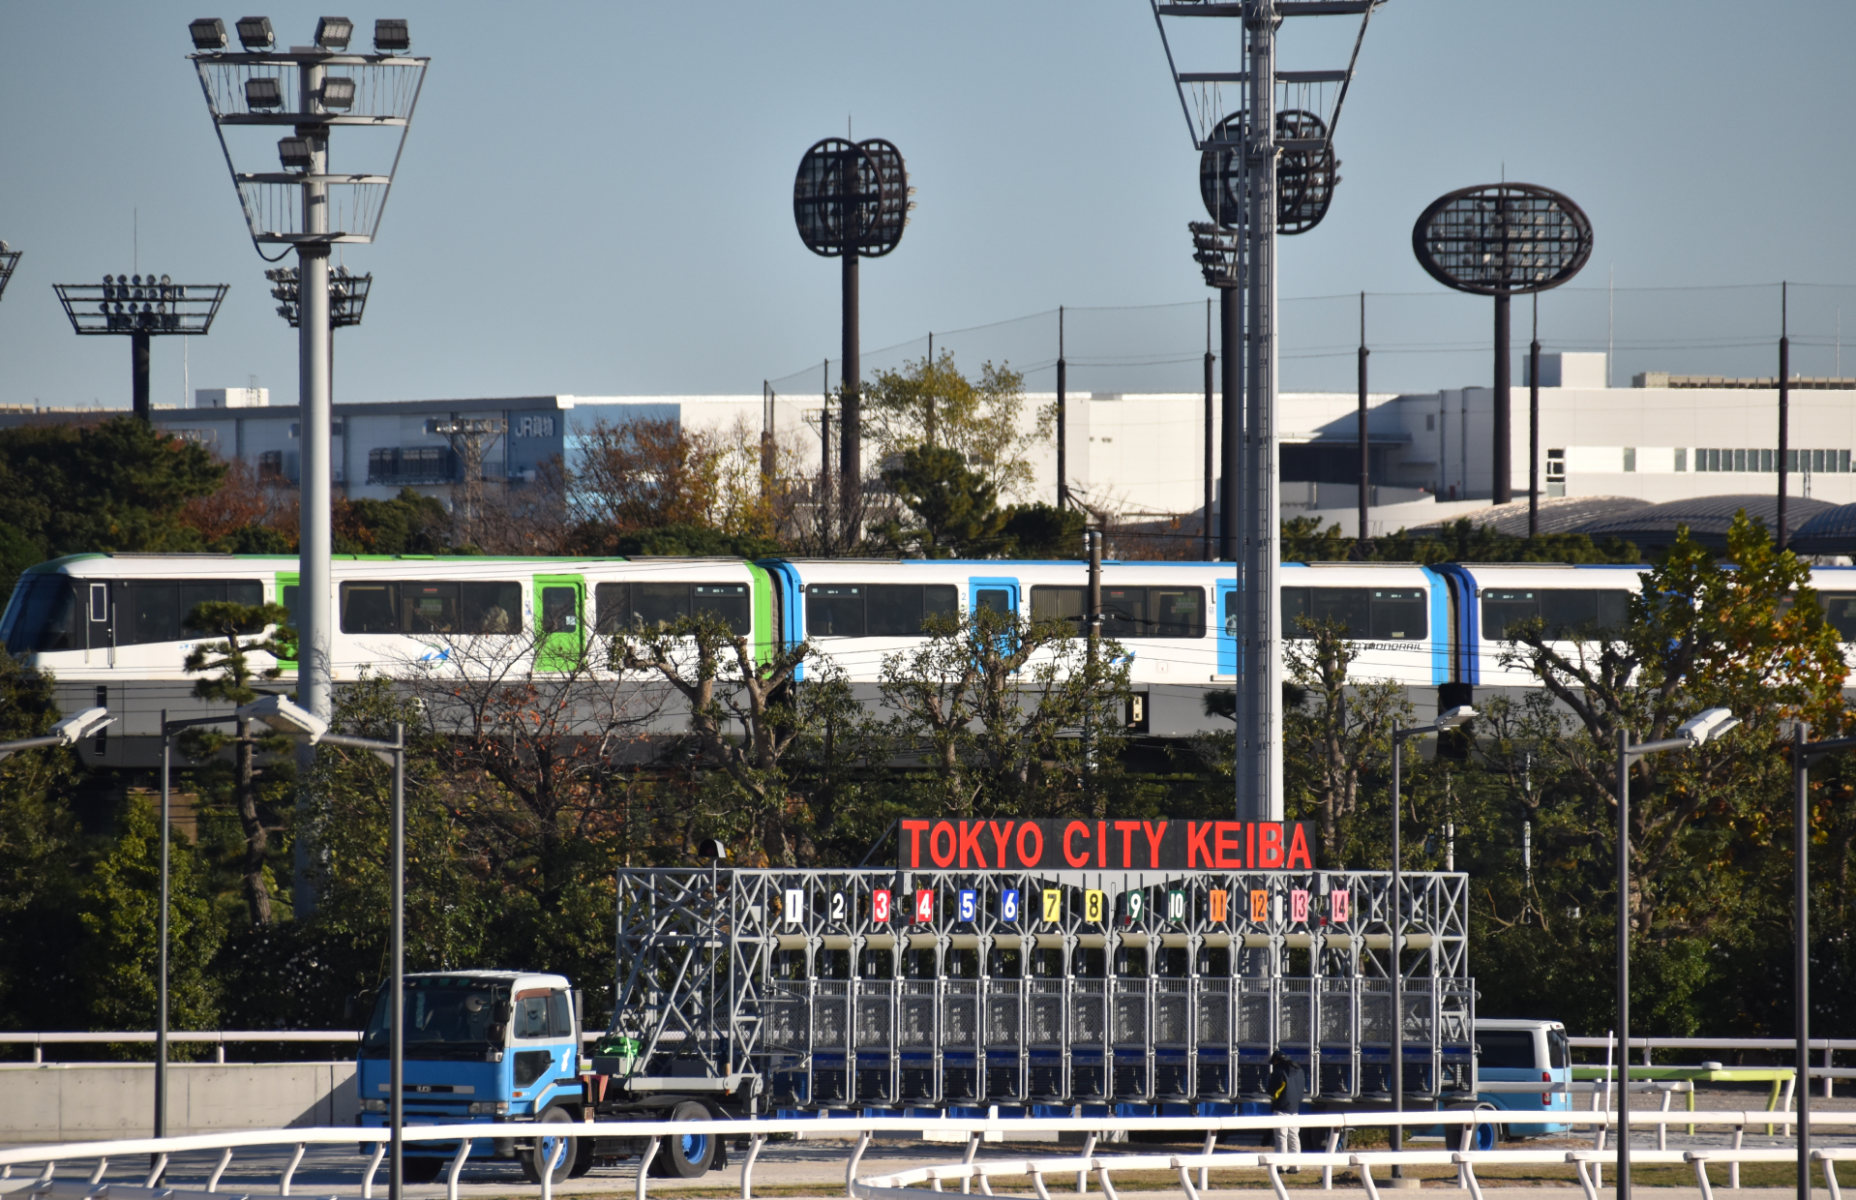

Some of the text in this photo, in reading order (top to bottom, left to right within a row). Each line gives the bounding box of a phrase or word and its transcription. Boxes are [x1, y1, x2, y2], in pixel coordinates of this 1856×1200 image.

[515, 415, 554, 437] JR貨物
[961, 592, 967, 601] 2
[902, 820, 1312, 869] TOKYO CITY KEIBA
[832, 893, 844, 919] 2
[876, 893, 888, 919] 3
[919, 893, 931, 919] 4
[962, 893, 973, 919] 5
[1004, 893, 1016, 919] 6
[1047, 893, 1057, 919] 7
[1089, 893, 1099, 919] 8
[1130, 893, 1141, 919] 9
[1170, 893, 1183, 919] 10
[1213, 894, 1224, 918] 11
[1253, 894, 1265, 918] 12
[1294, 894, 1305, 918] 13
[1334, 894, 1346, 918] 14
